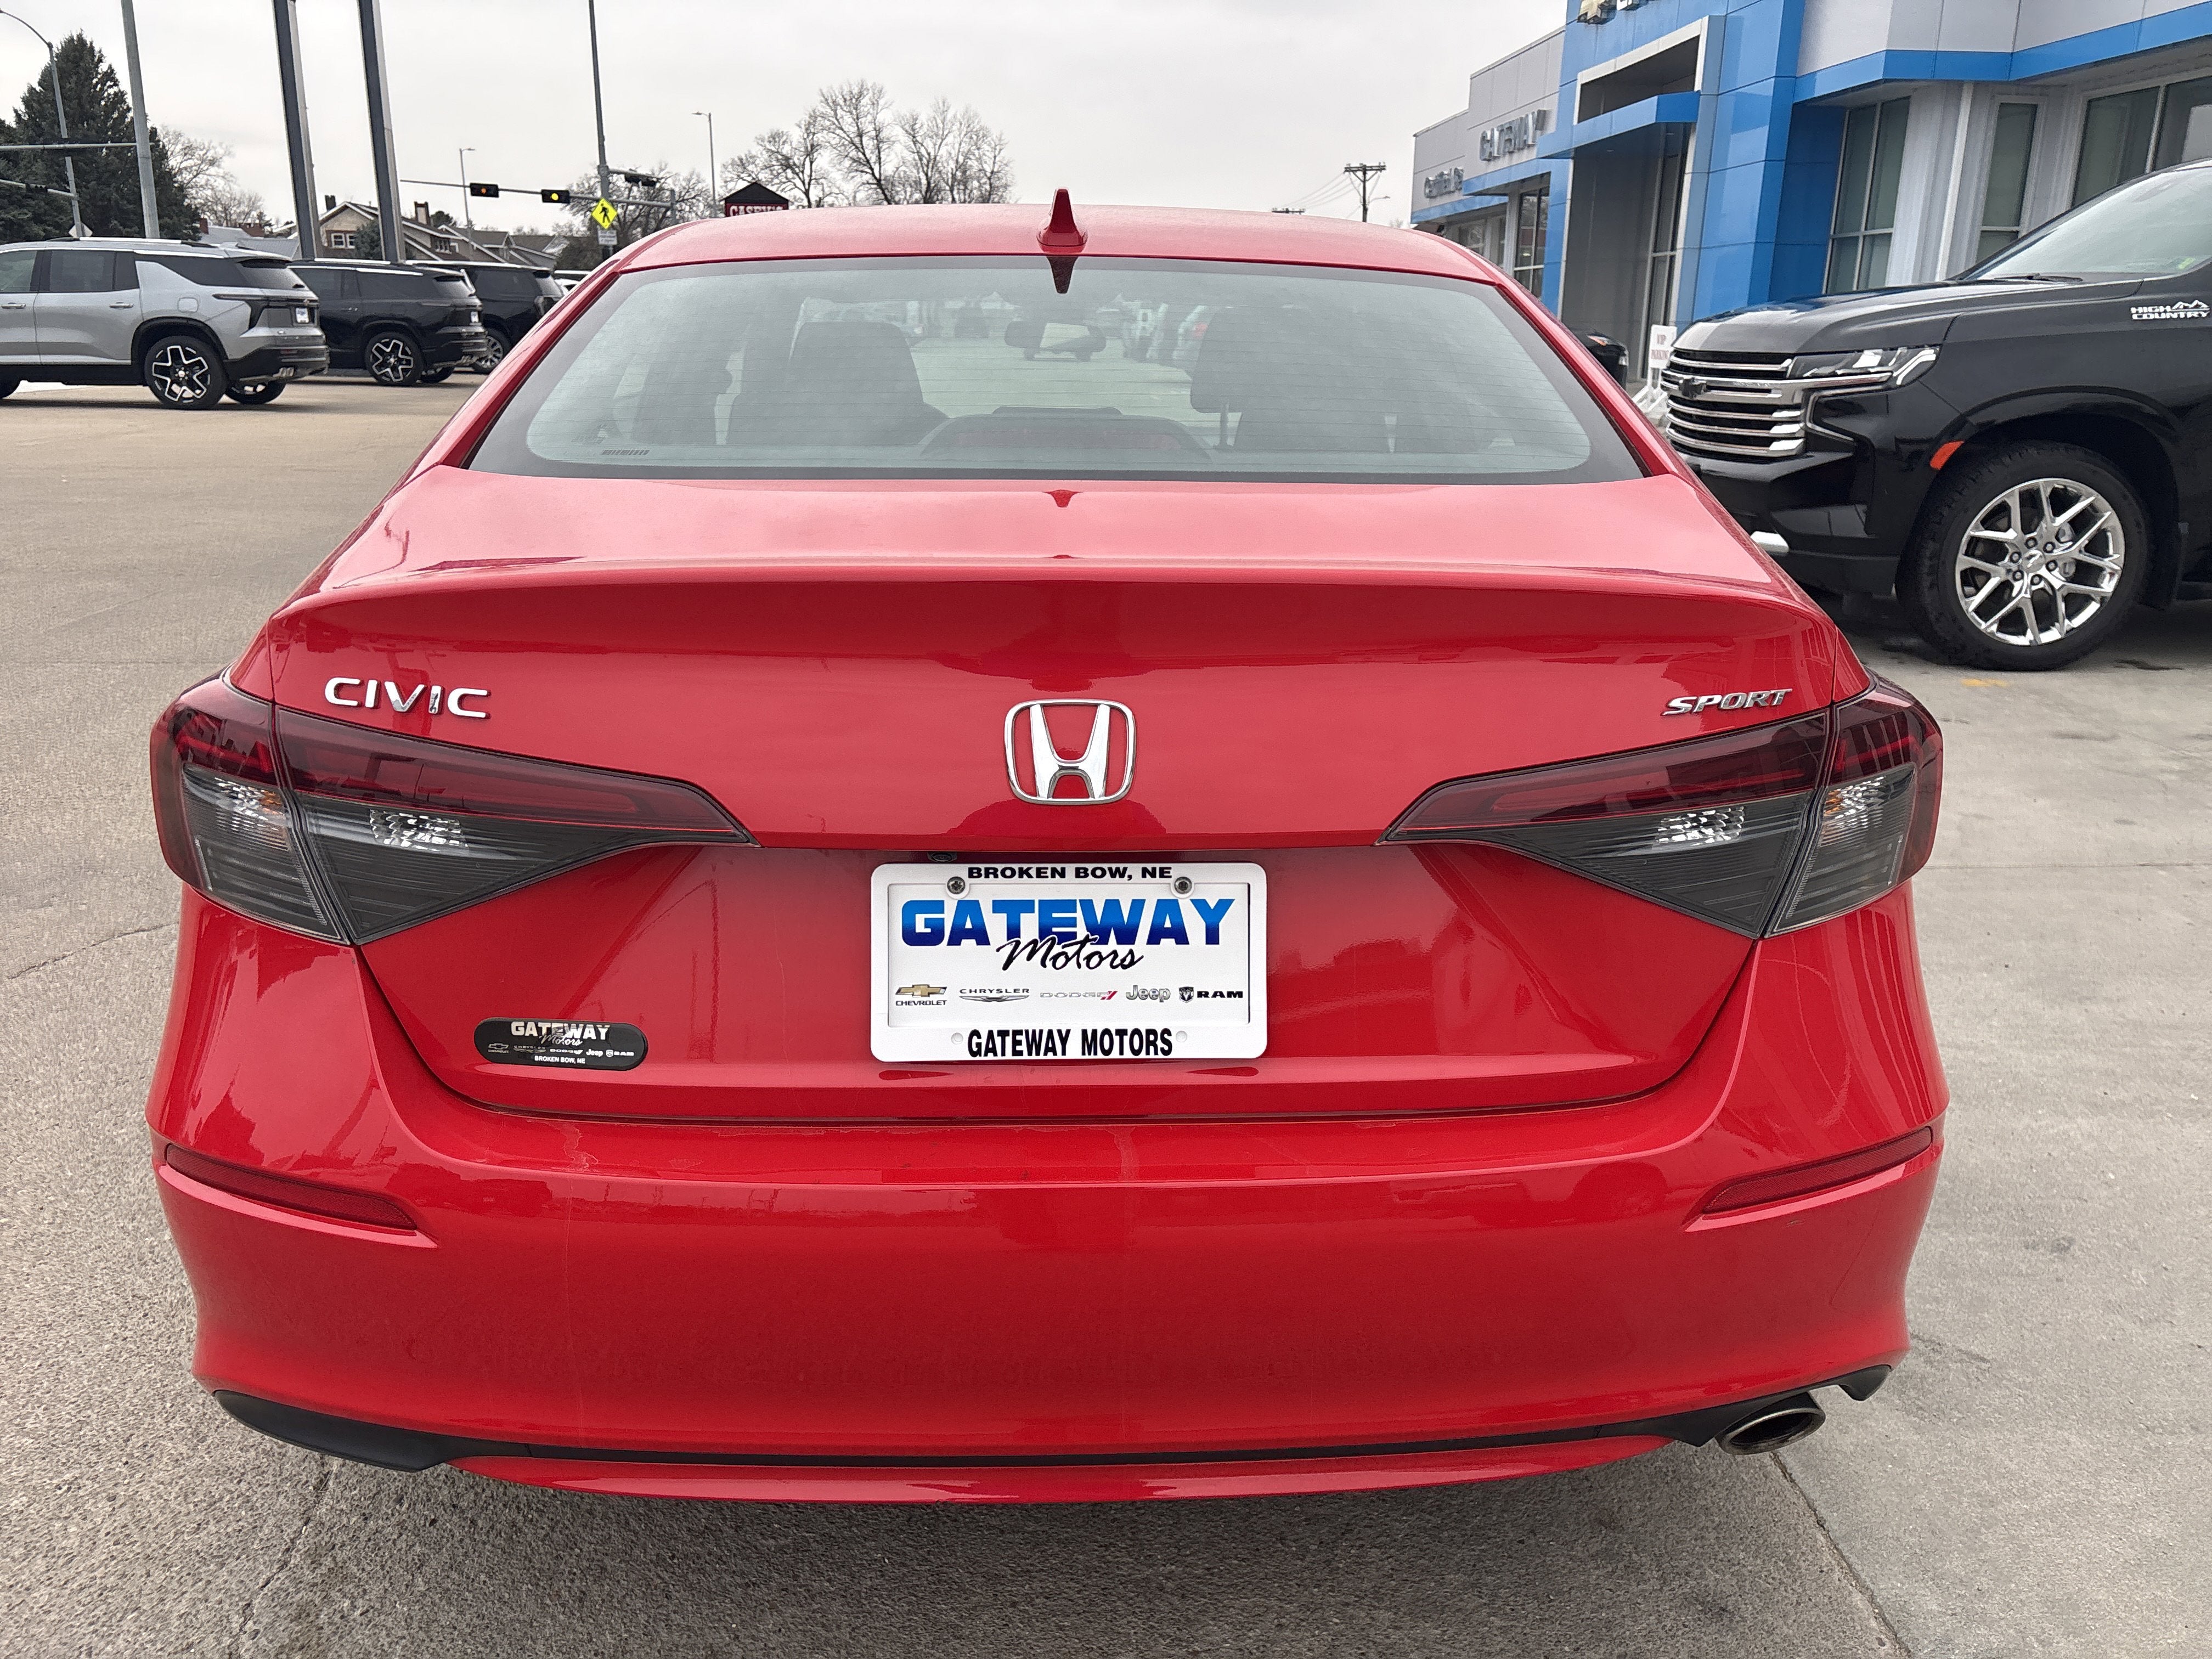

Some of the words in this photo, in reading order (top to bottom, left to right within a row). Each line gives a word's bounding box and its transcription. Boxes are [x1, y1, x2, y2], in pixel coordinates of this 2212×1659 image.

[2130, 305, 2171, 314] HIGH
[2132, 311, 2210, 320] COUNTRY
[325, 677, 488, 719] CIVIC
[1662, 688, 1793, 715] SPORT
[967, 866, 1066, 879] BROKEN
[1075, 866, 1132, 881] BOW,
[1141, 866, 1172, 878] NE
[901, 898, 1235, 946] GATEWAY
[995, 934, 1144, 971] Motors
[1125, 985, 1171, 1003] Jeep
[1197, 990, 1243, 998] RAM
[511, 1021, 611, 1040] GATEWAY
[538, 1031, 583, 1046] Motors
[967, 1029, 1070, 1058] GATEWAY
[1081, 1028, 1173, 1057] MOTORS
